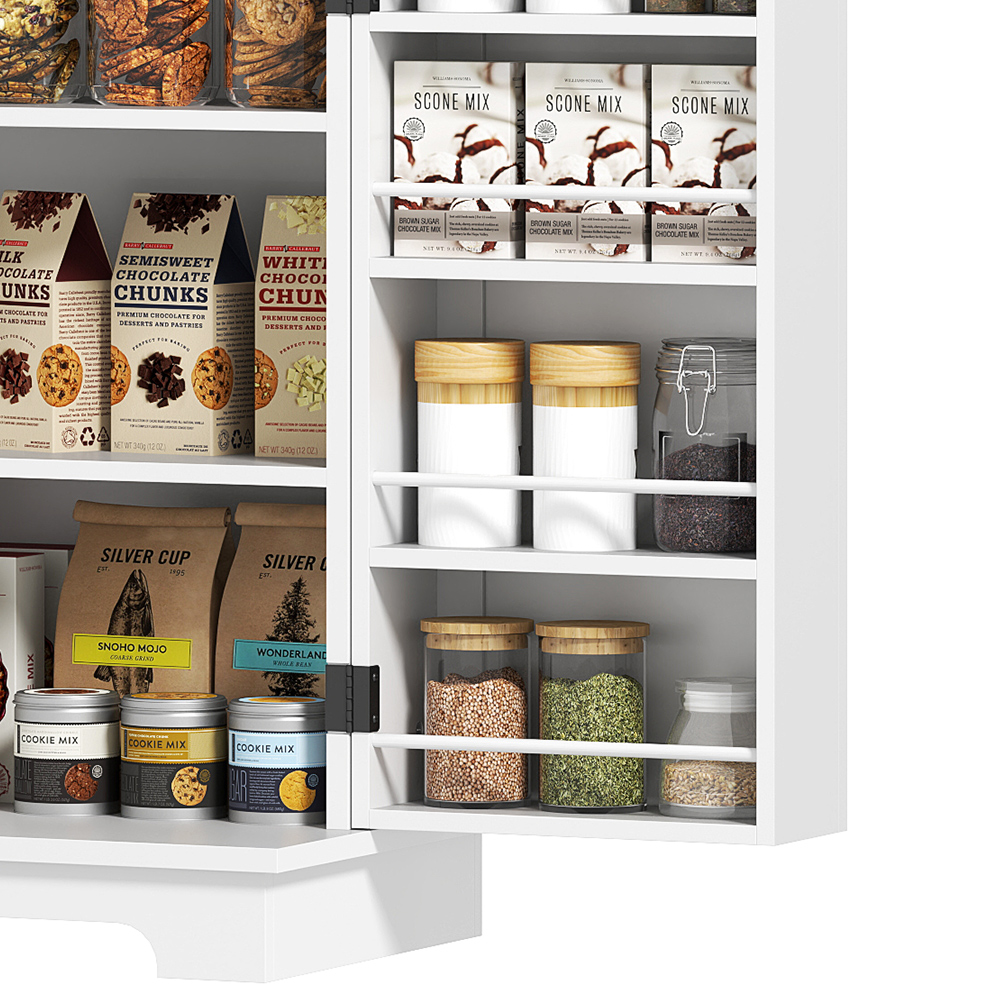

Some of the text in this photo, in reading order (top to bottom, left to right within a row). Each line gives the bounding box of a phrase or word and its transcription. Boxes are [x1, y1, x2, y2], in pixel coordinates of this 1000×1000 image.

[414, 92, 490, 111] SCONE MIX
[546, 94, 622, 113] SCONE MIX
[672, 96, 749, 115] SCONE MIX
[399, 217, 419, 225] BROWN
[553, 220, 572, 228] SUGAR
[397, 225, 441, 233] CHOCOLATE MIX
[529, 227, 564, 235] CHOCOLATE
[119, 255, 214, 268] SEMISWEET
[116, 270, 211, 282] CHOCOLATE
[114, 284, 208, 303] CHUNKS
[20, 318, 46, 326] PASTRIES
[100, 547, 191, 566] SILVER CUP
[263, 553, 316, 571] SILVER
[97, 642, 167, 654] SNOHO MOJO
[256, 648, 326, 660] WONDERLAND
[21, 735, 78, 744] COOKIE MIX
[128, 739, 186, 749] COOKIE MIX
[236, 743, 295, 753] COOKIE MIX
